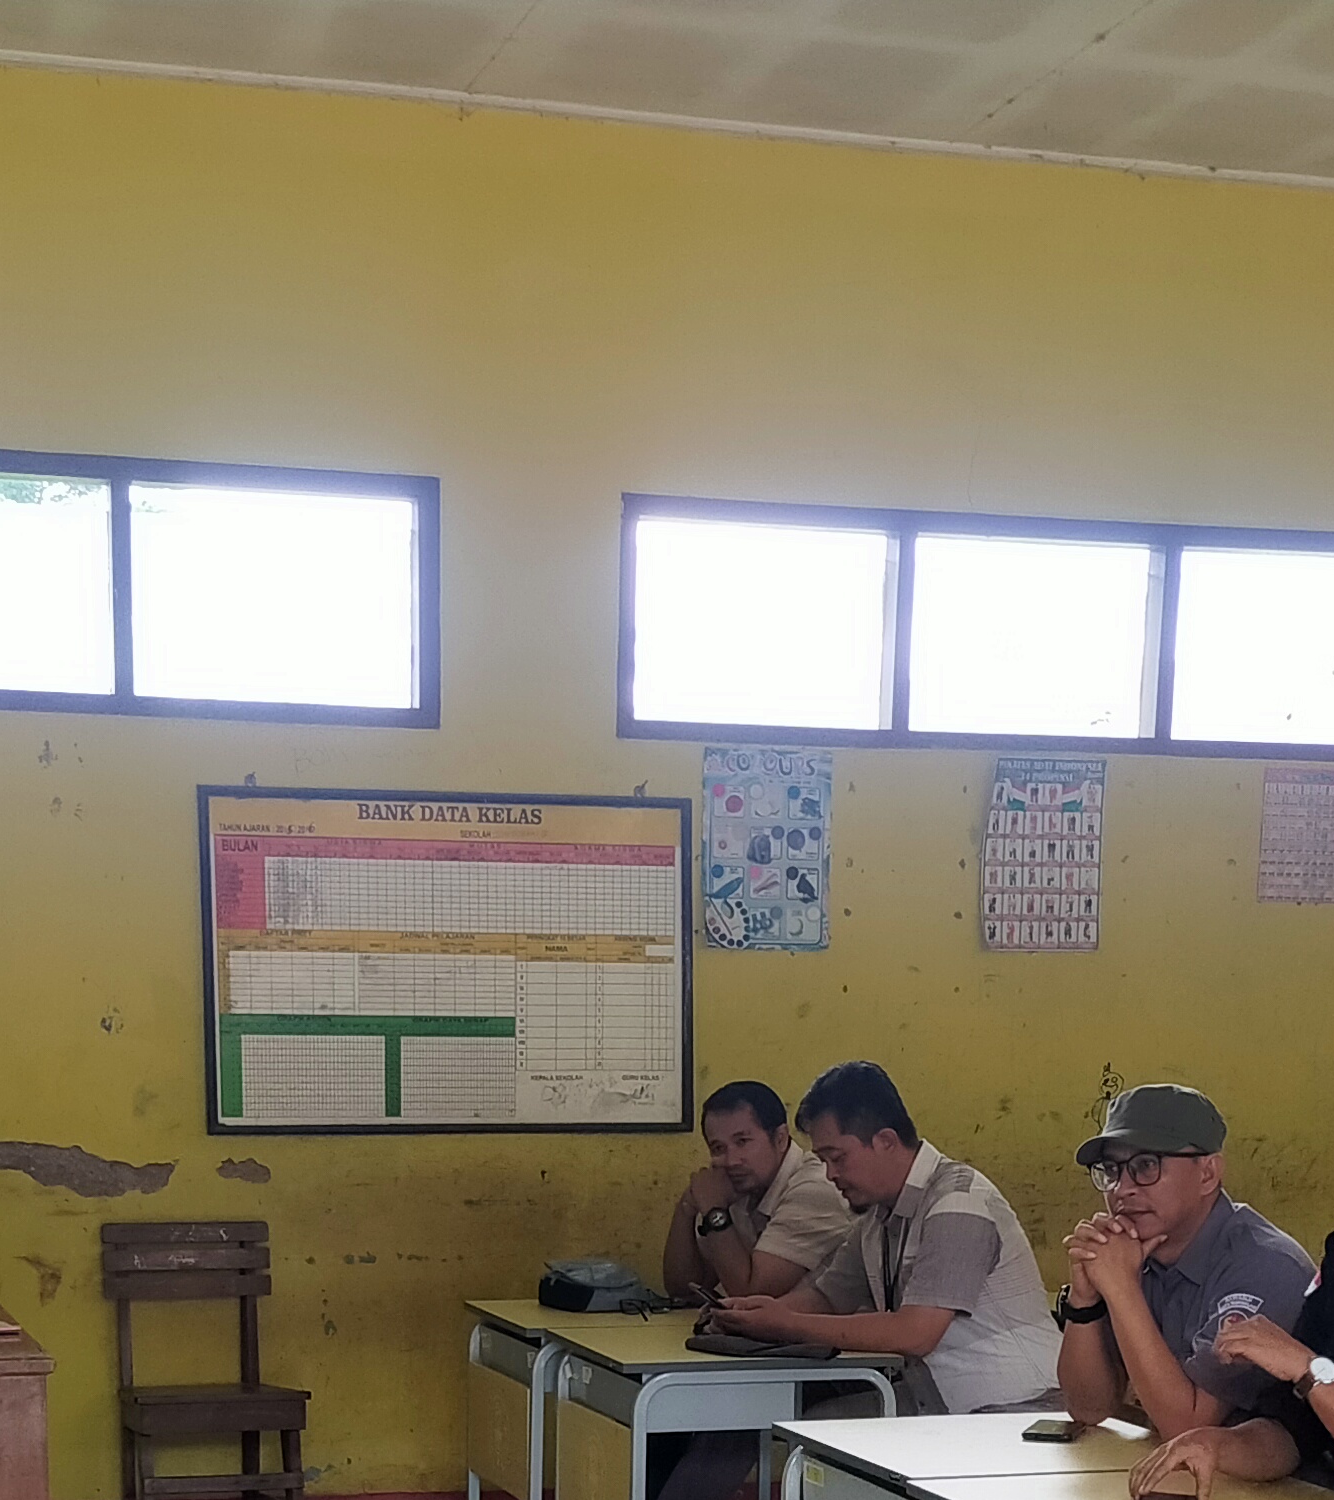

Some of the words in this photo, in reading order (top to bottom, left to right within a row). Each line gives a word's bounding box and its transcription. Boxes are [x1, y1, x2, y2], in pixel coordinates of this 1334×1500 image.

[357, 803, 415, 822] BANK
[419, 805, 472, 823] DATA
[476, 807, 542, 825] KELAS
[221, 838, 259, 852] BULAN
